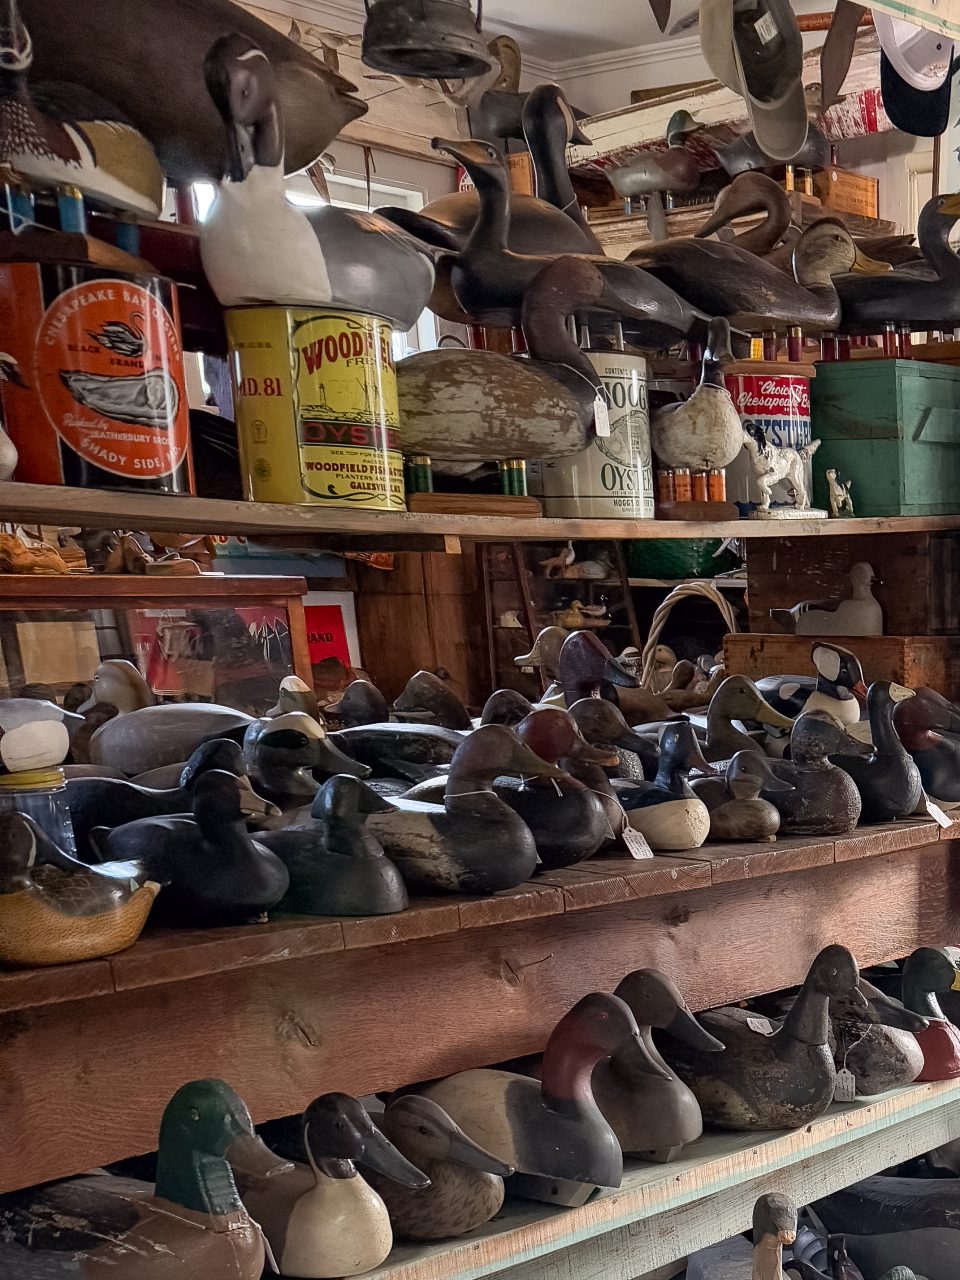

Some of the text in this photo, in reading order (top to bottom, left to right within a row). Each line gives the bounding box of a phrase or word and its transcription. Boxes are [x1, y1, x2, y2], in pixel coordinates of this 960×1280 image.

[263, 377, 284, 397] 81
[80, 437, 128, 466] SHADY
[304, 461, 368, 474] WOODFIELD
